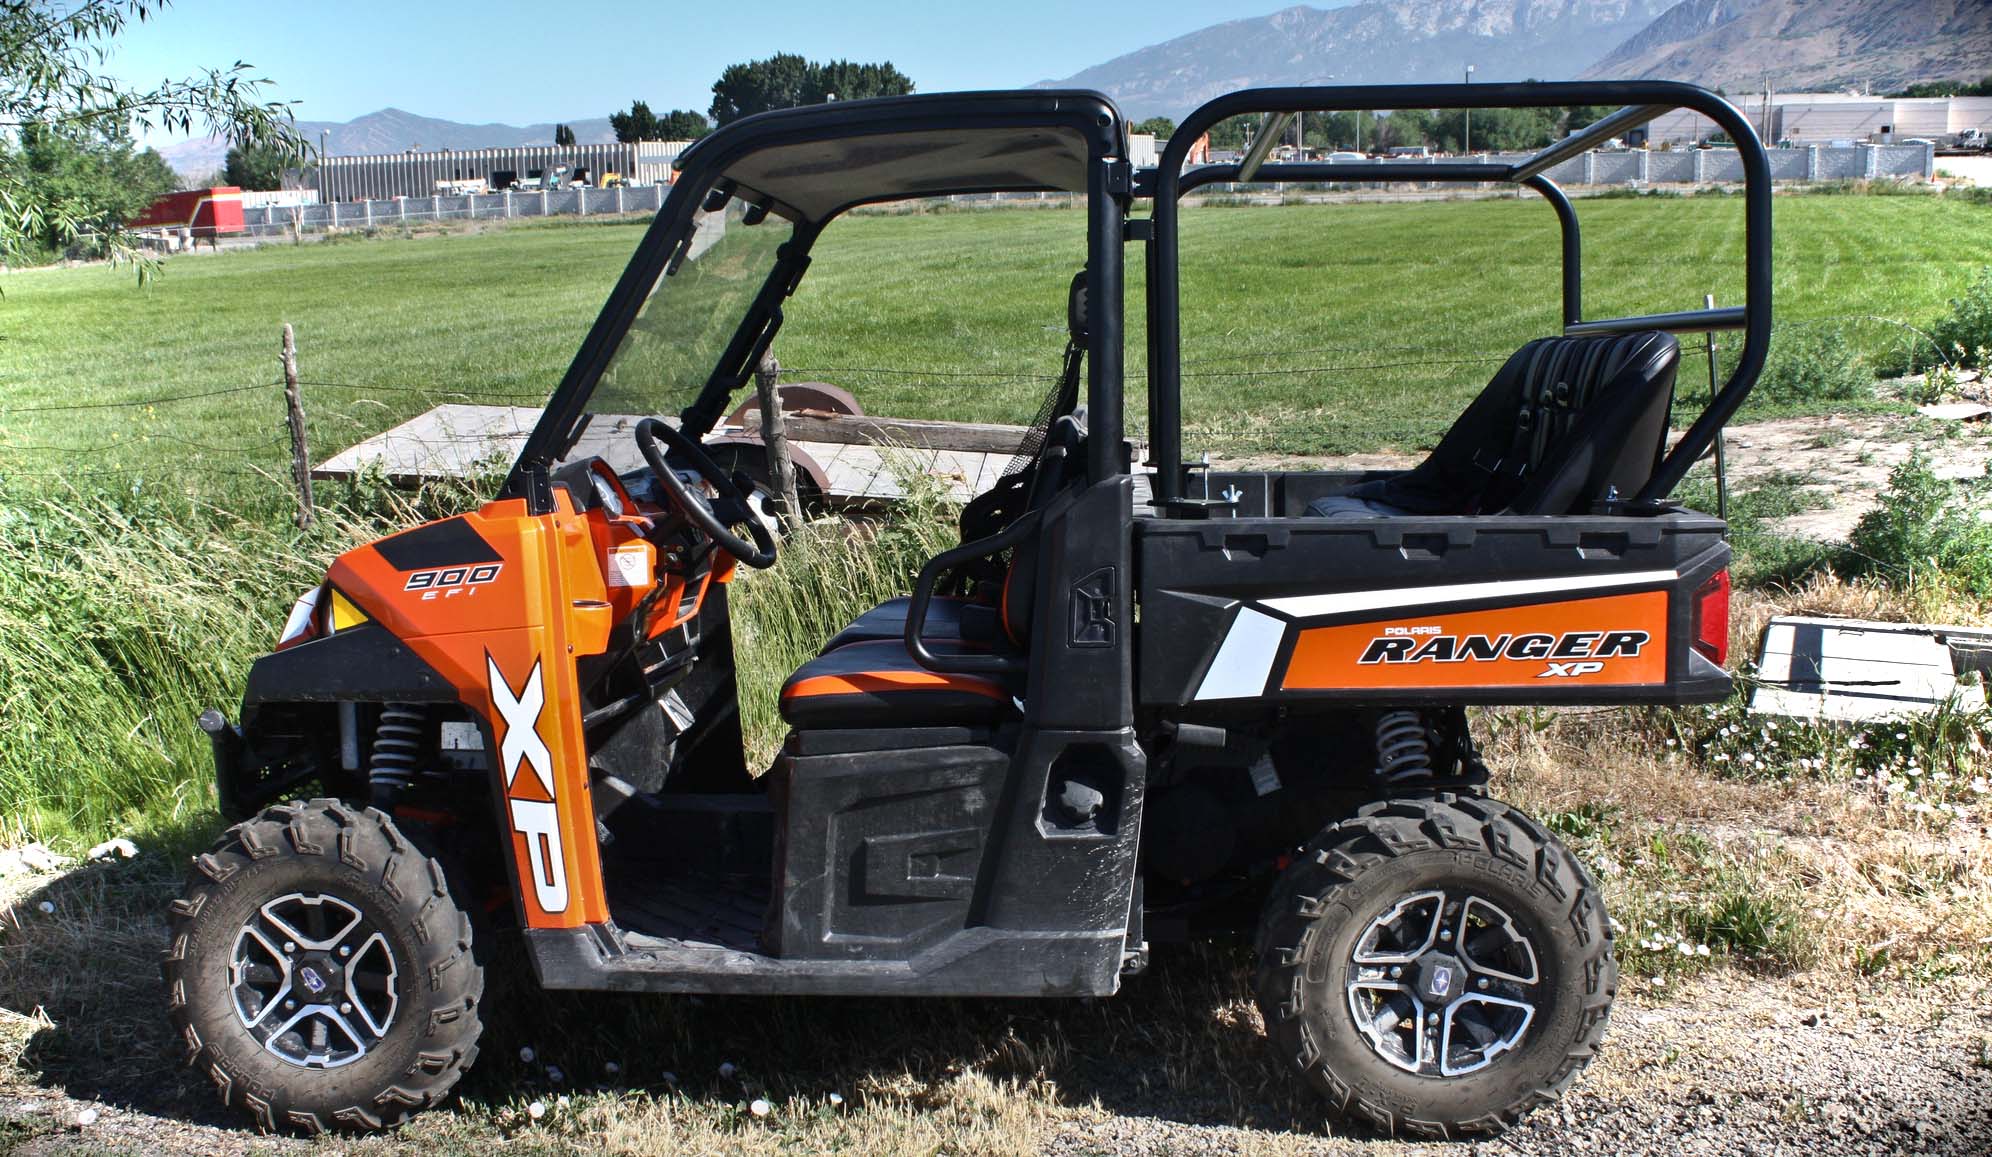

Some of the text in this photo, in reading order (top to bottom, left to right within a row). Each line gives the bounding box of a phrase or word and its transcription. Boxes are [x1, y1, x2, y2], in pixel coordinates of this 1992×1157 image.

[404, 564, 503, 591] 900
[421, 587, 476, 600] EFI
[1384, 625, 1442, 636] POLARIS
[1357, 630, 1651, 664] RANGER
[1536, 661, 1605, 678] XP
[486, 648, 569, 913] XP
